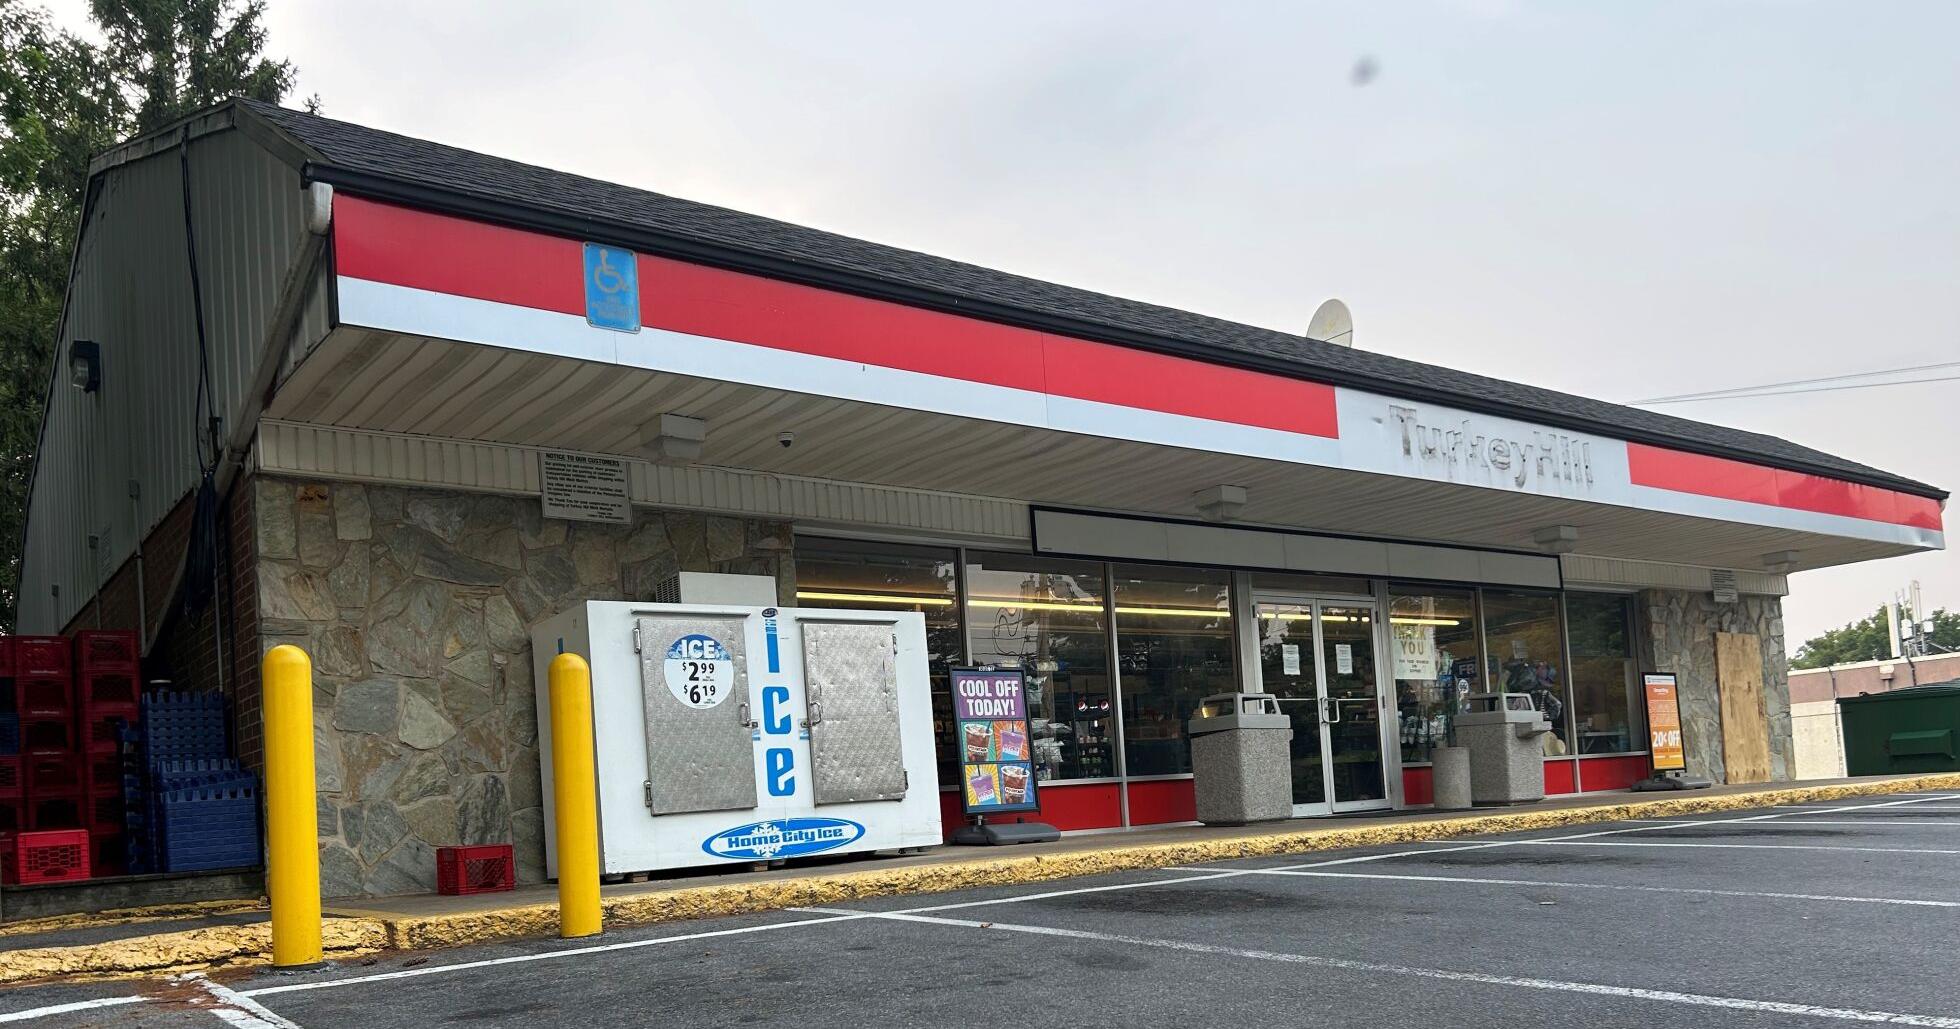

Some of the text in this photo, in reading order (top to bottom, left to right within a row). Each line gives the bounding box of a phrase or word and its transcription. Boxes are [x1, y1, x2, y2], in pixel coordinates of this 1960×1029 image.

[546, 453, 565, 461] NOTICE
[588, 457, 620, 467] CUSTOMERS
[682, 639, 716, 659] ICE
[1400, 640, 1424, 655] YOU
[959, 679, 1018, 697] COOL OFF
[966, 698, 1016, 716] TODAY!
[1667, 730, 1681, 748] OFF
[728, 828, 843, 848] Home City Ice
